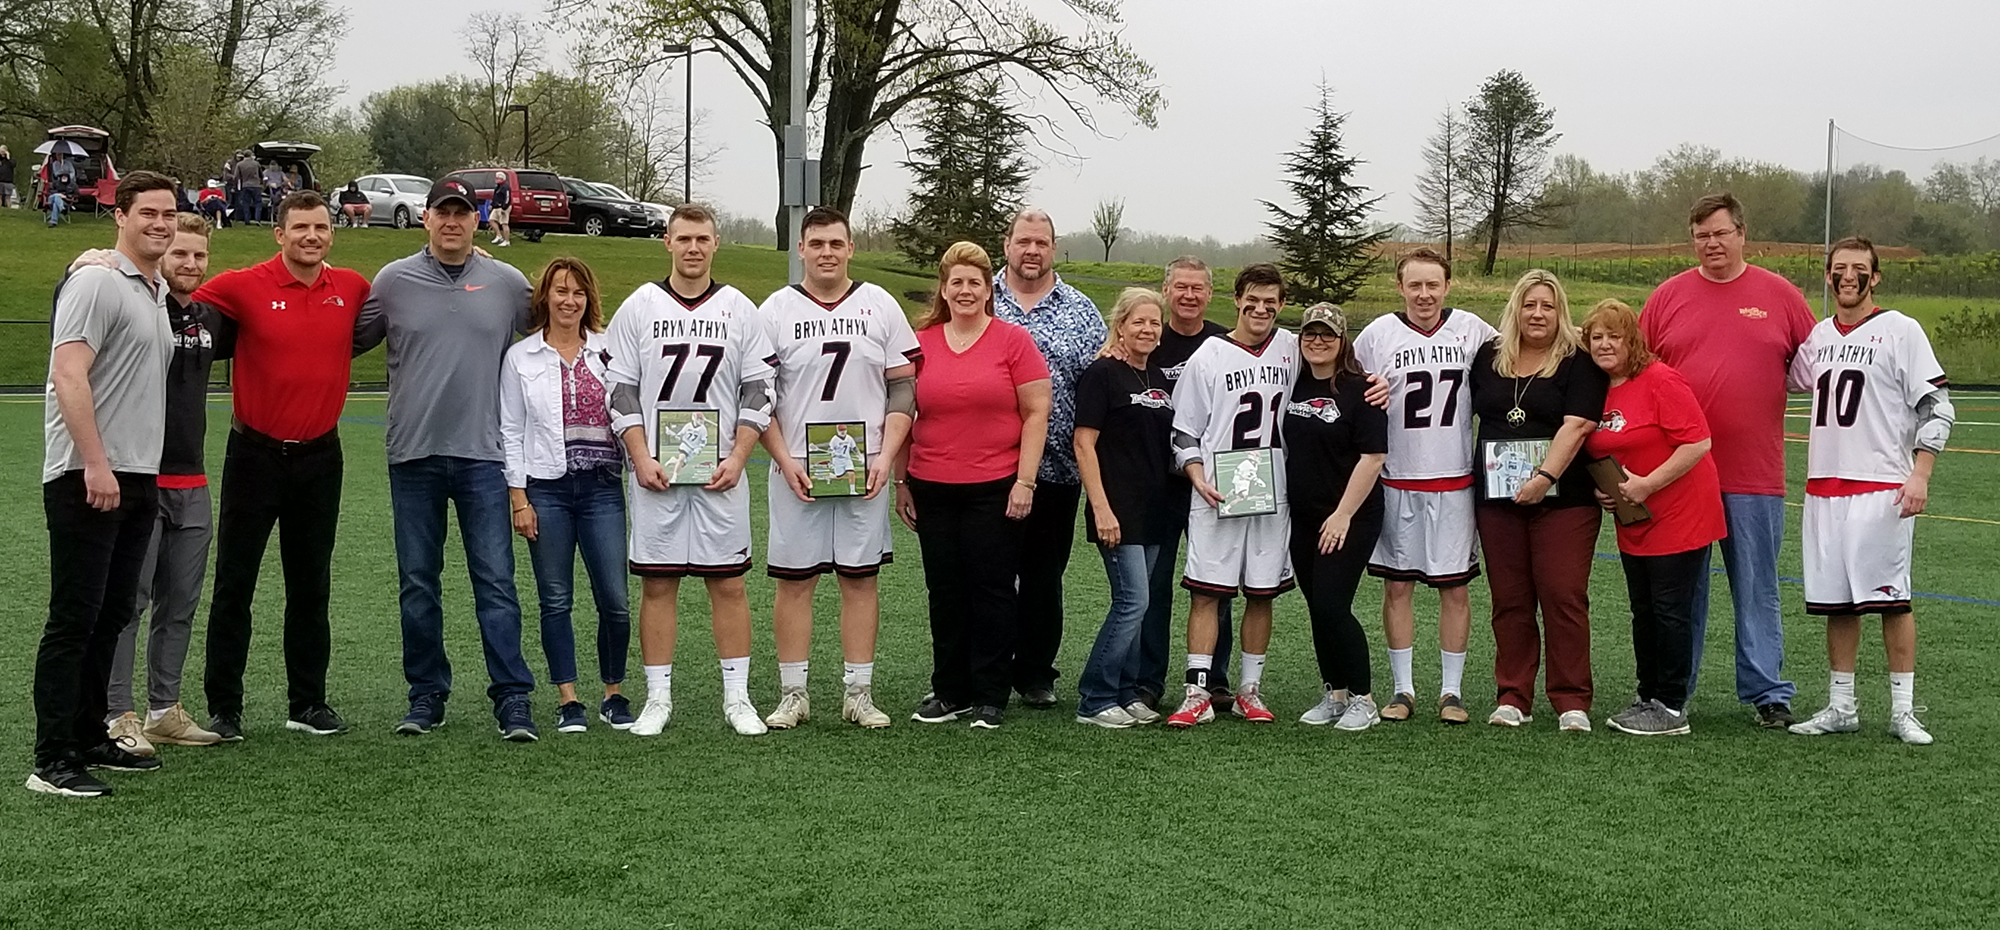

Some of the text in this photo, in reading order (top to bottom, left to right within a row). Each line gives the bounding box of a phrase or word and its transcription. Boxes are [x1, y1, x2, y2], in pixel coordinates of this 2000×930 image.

[653, 318, 729, 340] BRYN ATHYN
[794, 317, 869, 340] BRYN ATHYN
[657, 342, 725, 403] 77
[820, 340, 852, 402] 7
[1396, 345, 1467, 370] BRYN ATHYN
[1837, 344, 1878, 366] ATHYN
[1225, 365, 1291, 392] BRYN ATHYN
[1403, 368, 1465, 430] 27
[1815, 367, 1866, 428] 10
[1231, 390, 1284, 451] 21
